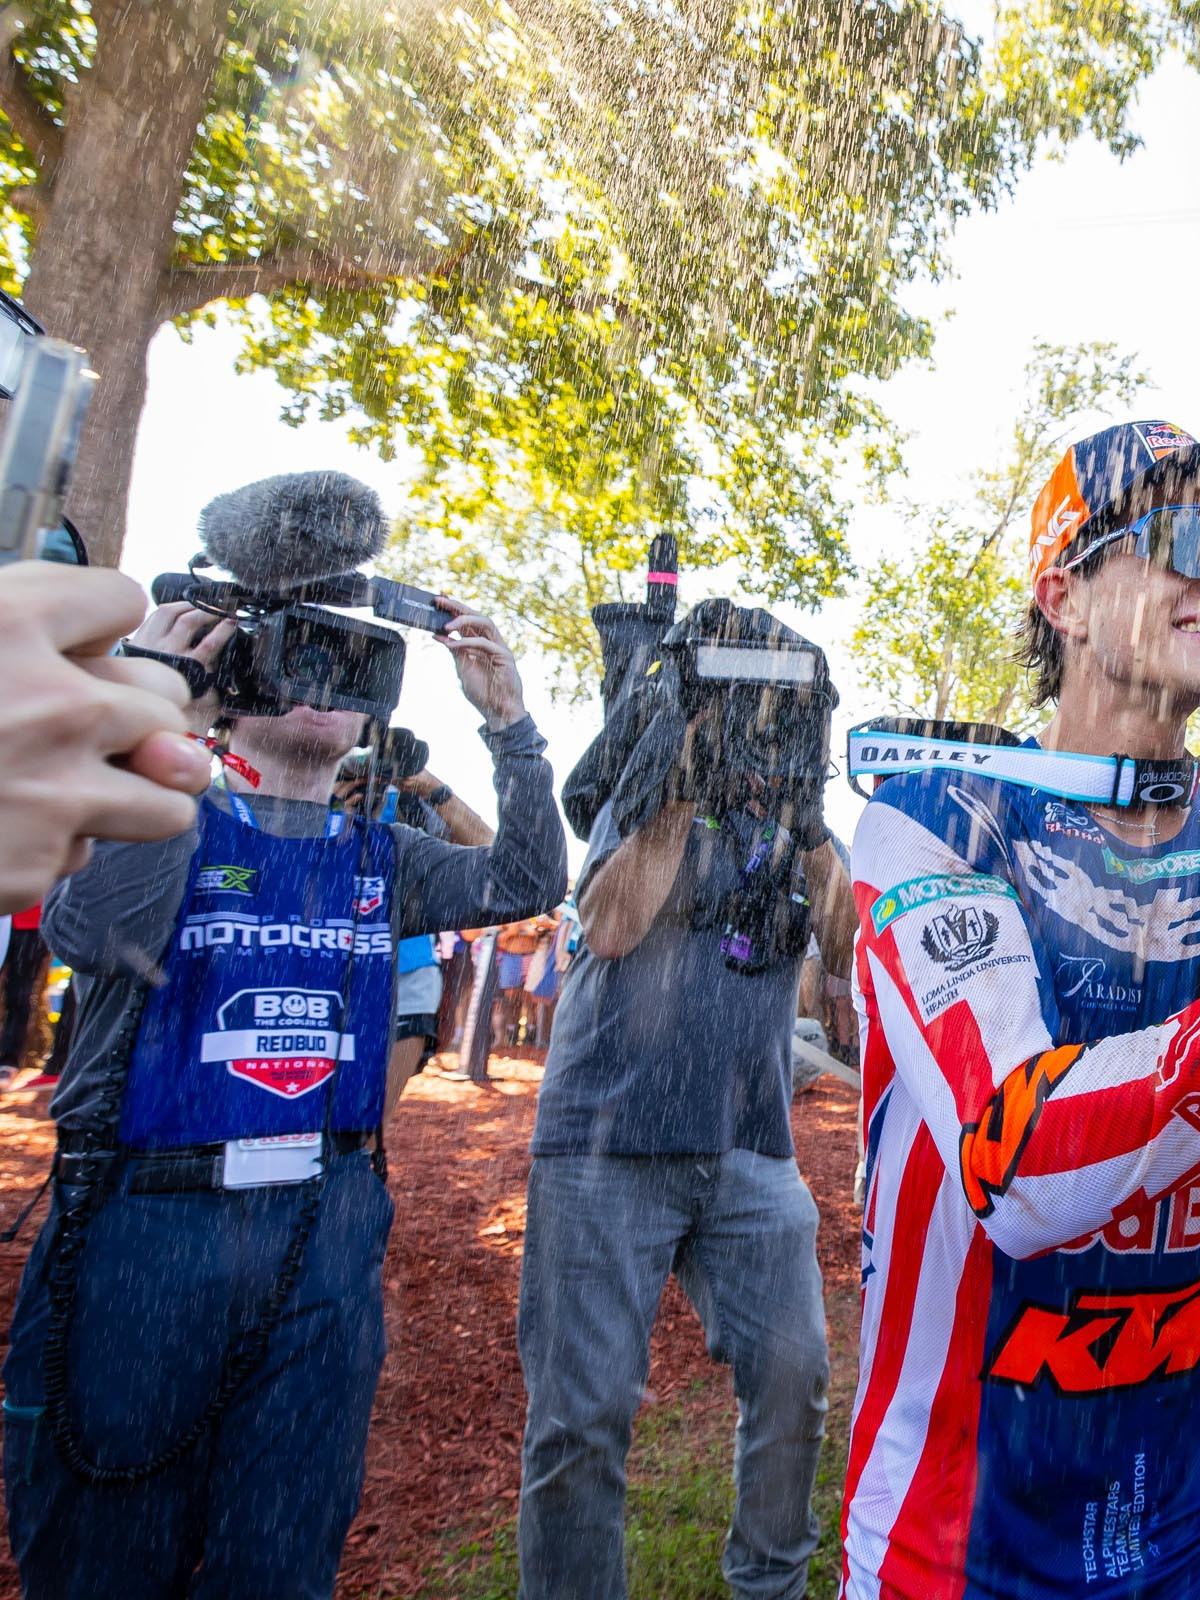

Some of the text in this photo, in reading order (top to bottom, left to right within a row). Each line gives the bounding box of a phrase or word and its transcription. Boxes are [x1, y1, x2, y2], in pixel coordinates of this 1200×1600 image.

[860, 745, 992, 765] OAKLEY
[1138, 771, 1192, 784] FACTORY PILOT
[262, 914, 324, 928] PRO
[180, 921, 393, 955] MOTOCROSS
[921, 953, 1032, 1005] LOMA LINDA UNIVERSITY
[254, 994, 330, 1019] BOB
[925, 988, 960, 1017] HEALTH
[254, 1018, 276, 1027] THE
[278, 1018, 317, 1028] COOLER
[256, 1035, 327, 1053] REDBUD
[1133, 1452, 1146, 1513] EDITION
[1082, 1501, 1098, 1584] TECHSTAR
[1102, 1480, 1121, 1578] ALPINESTARS
